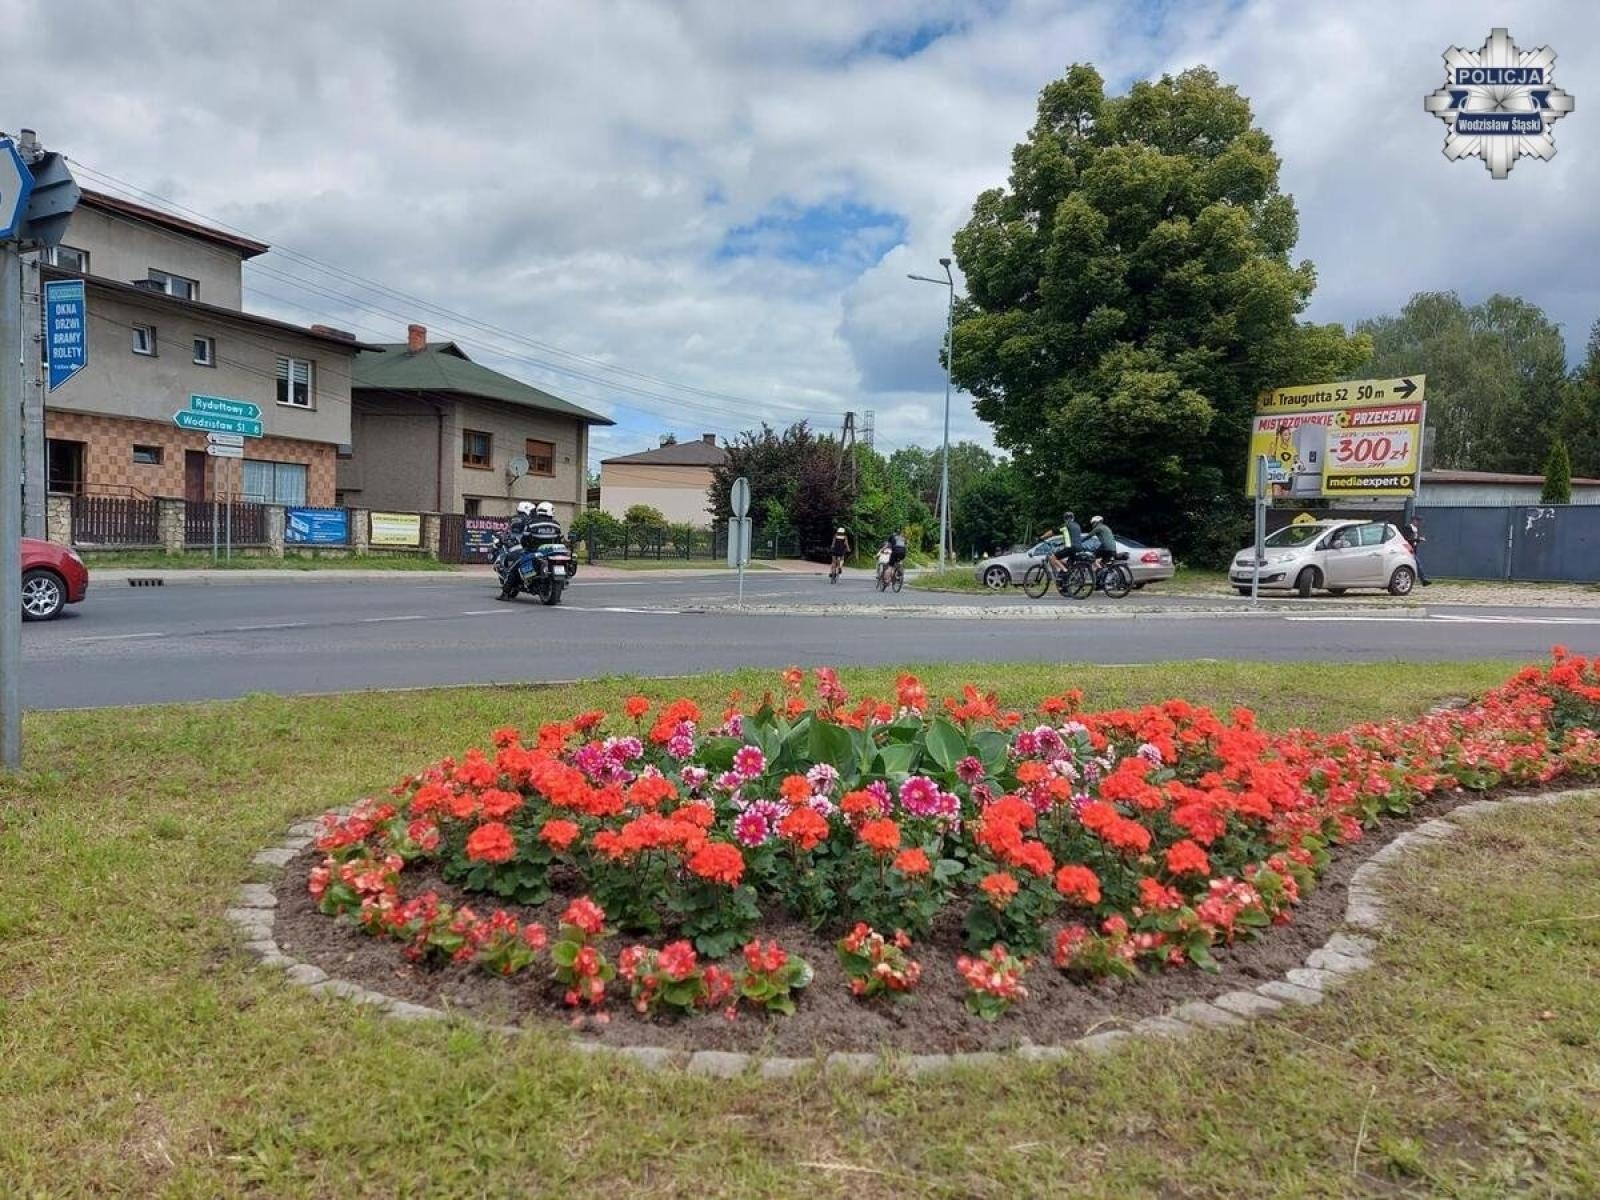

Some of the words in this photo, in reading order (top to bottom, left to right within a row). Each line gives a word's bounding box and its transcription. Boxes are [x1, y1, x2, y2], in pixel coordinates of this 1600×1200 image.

[55, 303, 77, 315] OKNA
[55, 318, 80, 329] DRZWI
[53, 333, 81, 344] BRAMY
[53, 347, 82, 358] ROLETY
[1263, 394, 1276, 407] ul.
[1279, 392, 1332, 407] Traugutta
[1335, 388, 1349, 402] 52
[1356, 385, 1374, 401] 50
[1374, 389, 1385, 399] m
[247, 406, 254, 417] 2
[183, 415, 233, 431] Wodzisław
[1329, 476, 1399, 488] mediaexpert
